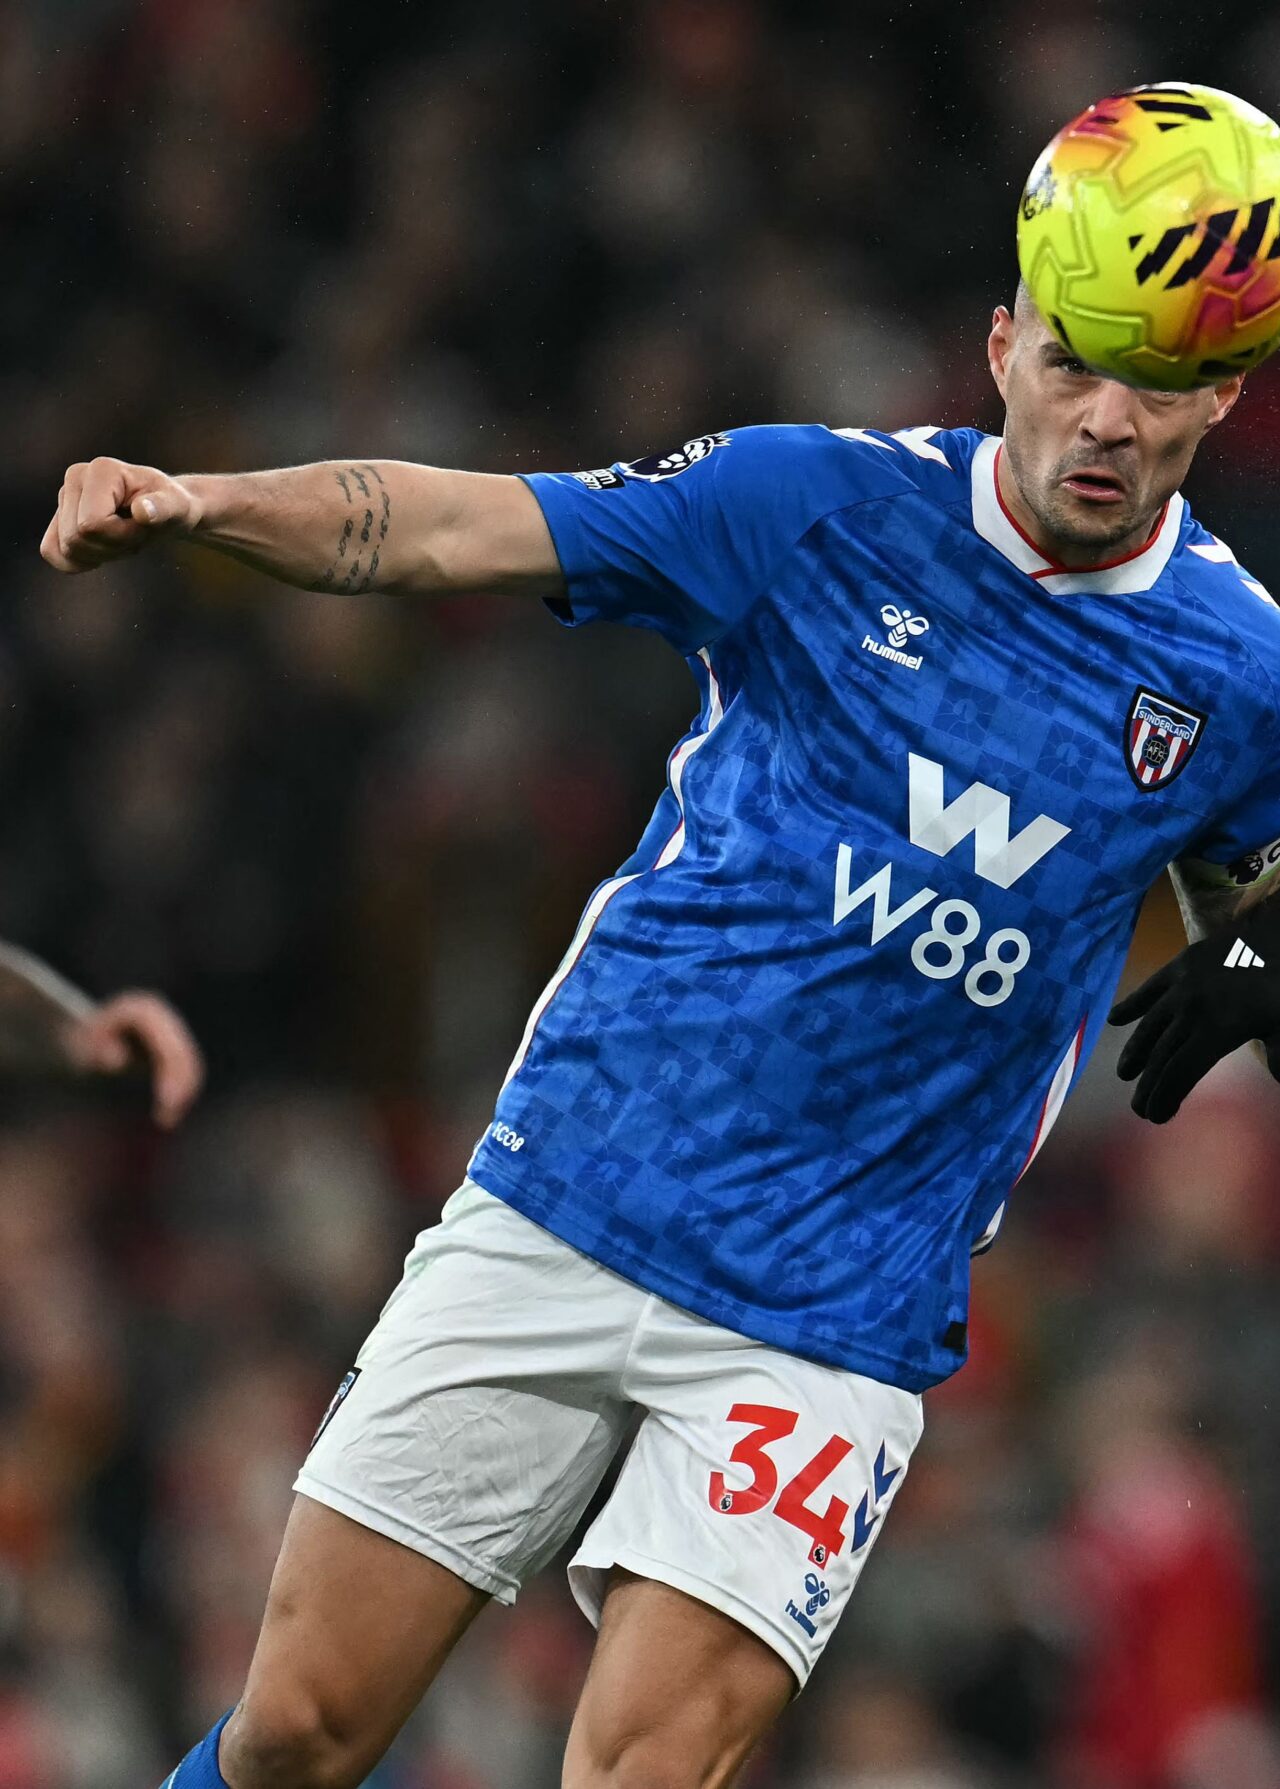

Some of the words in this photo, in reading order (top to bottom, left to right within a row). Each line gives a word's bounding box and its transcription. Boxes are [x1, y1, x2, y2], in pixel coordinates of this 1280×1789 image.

[861, 634, 924, 671] hummel
[1138, 710, 1190, 740] SUNDERLAND
[1147, 745, 1165, 758] AFC
[908, 752, 1072, 890] W
[833, 842, 1031, 1007] W88
[708, 1402, 856, 1571] 34
